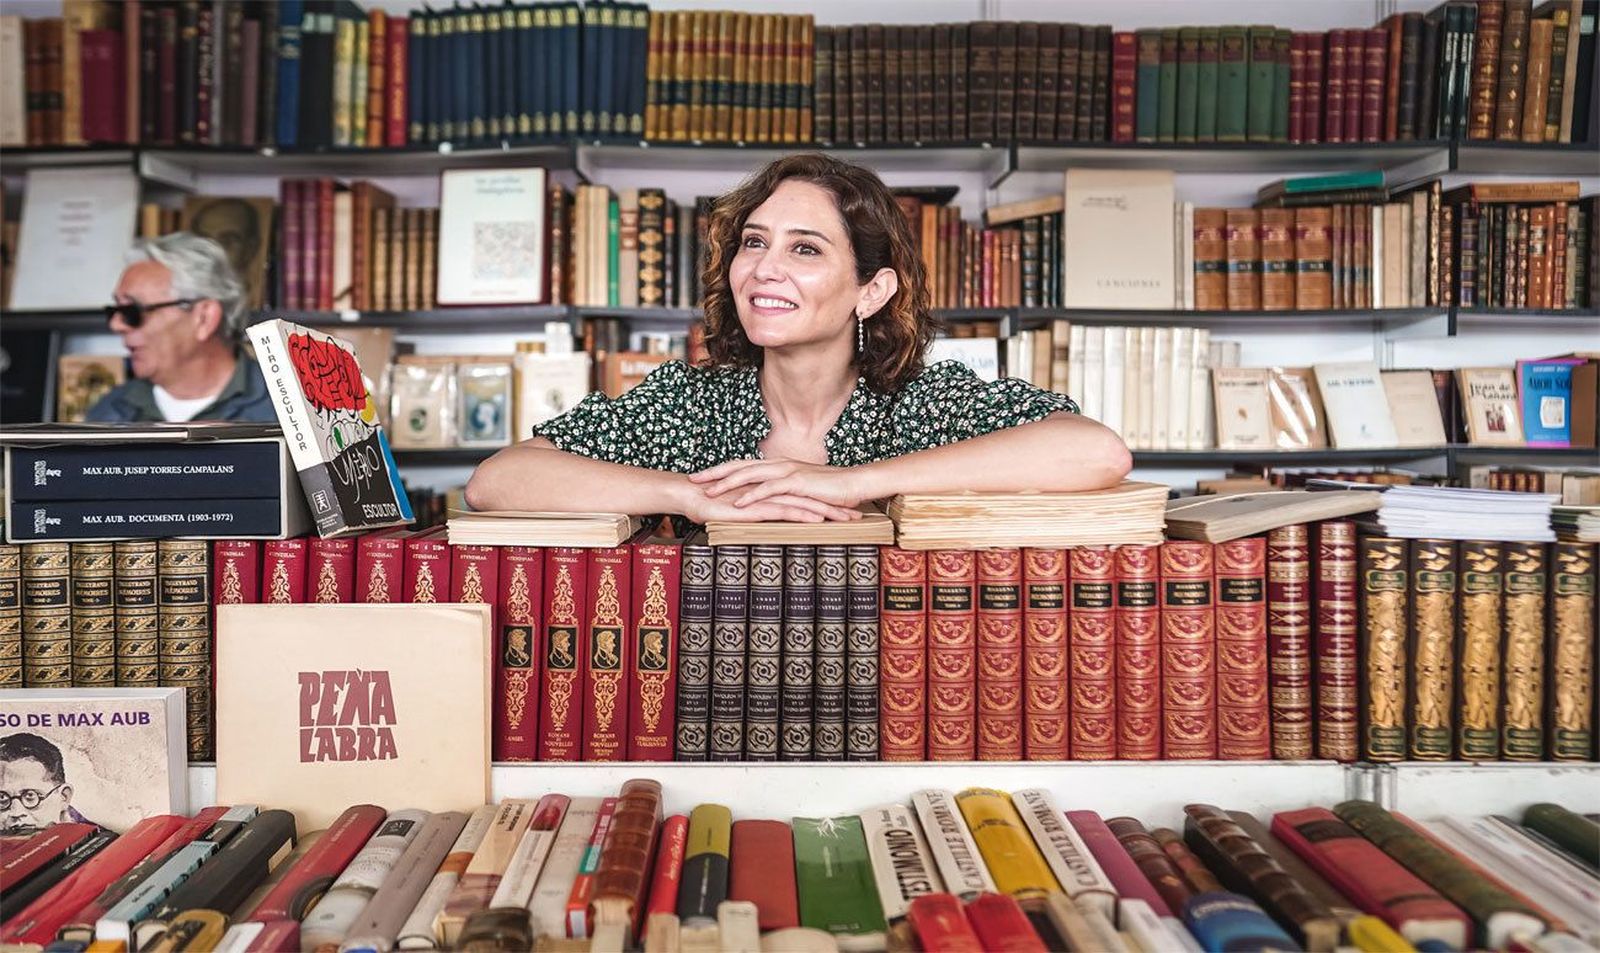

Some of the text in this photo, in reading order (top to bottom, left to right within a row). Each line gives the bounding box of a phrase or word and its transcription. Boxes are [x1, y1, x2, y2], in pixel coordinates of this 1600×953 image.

[261, 336, 307, 451] MIRO ESCULTOR
[83, 465, 234, 476] MAX AUB. JUSEP TORRES CAMPALANS
[105, 515, 126, 523] AUB.
[129, 514, 185, 522] DOCUMENTA
[188, 513, 234, 523] (1903-1972)
[362, 503, 399, 519] ESCULTOR
[298, 668, 397, 727] PEÑA
[27, 714, 52, 727] DE
[58, 713, 104, 727] MAX
[110, 712, 150, 725] AUB
[300, 728, 398, 762] LABRA
[884, 829, 933, 899] TESTIMONIO
[1051, 835, 1099, 886] CASTILLE
